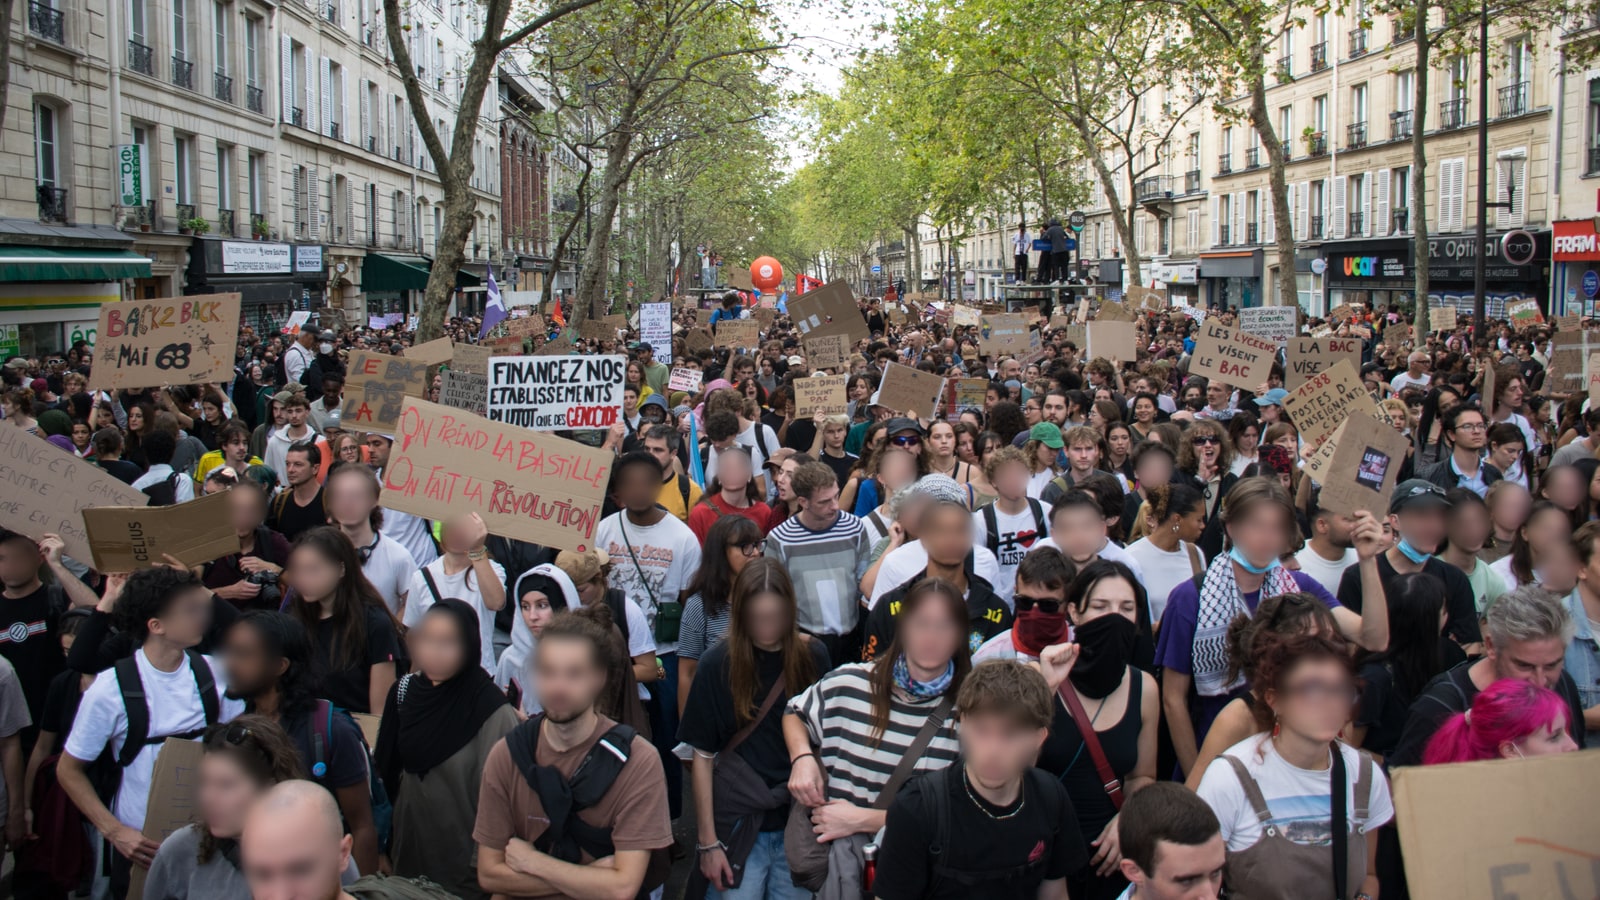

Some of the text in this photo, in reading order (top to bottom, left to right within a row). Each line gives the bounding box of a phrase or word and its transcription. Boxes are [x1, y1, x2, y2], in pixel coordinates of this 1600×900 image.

[121, 147, 132, 194] épi
[1071, 215, 1084, 223] BUS
[1446, 239, 1499, 260] Optial
[1554, 235, 1596, 253] FRAM
[1344, 256, 1378, 276] ucar
[180, 301, 221, 324] BACK
[71, 325, 97, 347] ép
[1208, 325, 1230, 340] LES
[155, 342, 192, 370] 68
[1299, 340, 1355, 354] LA BAC
[352, 354, 427, 383] LE BAC
[449, 372, 466, 382] NOUS
[493, 359, 623, 385] FINANCEZ NOS
[1199, 356, 1250, 378] LE BAC
[364, 380, 405, 404] PAS
[446, 390, 470, 399] CELLES
[460, 383, 474, 391] VOIX
[490, 382, 613, 405] ETABLISSEMENTS
[796, 378, 846, 389] NOS DROITS
[1298, 373, 1331, 398] 1588
[462, 400, 476, 409] ONT
[1291, 377, 1348, 420] POSTES D'
[342, 400, 373, 422] LA
[536, 414, 553, 427] QUE
[553, 413, 566, 426] DES
[1322, 407, 1350, 430] C'EST
[400, 406, 434, 452] ON
[437, 415, 489, 450] PREND
[492, 433, 514, 464] LA
[0, 429, 77, 480] HUNGER
[1310, 439, 1337, 471] OÙ EST
[0, 465, 54, 496] ENTRE
[385, 456, 420, 498] ON
[463, 476, 483, 506] LA
[29, 511, 50, 525] EN
[59, 520, 86, 539] POCH
[128, 521, 149, 561] CELIUS
[1001, 532, 1017, 551] I
[1001, 551, 1025, 566] LISB
